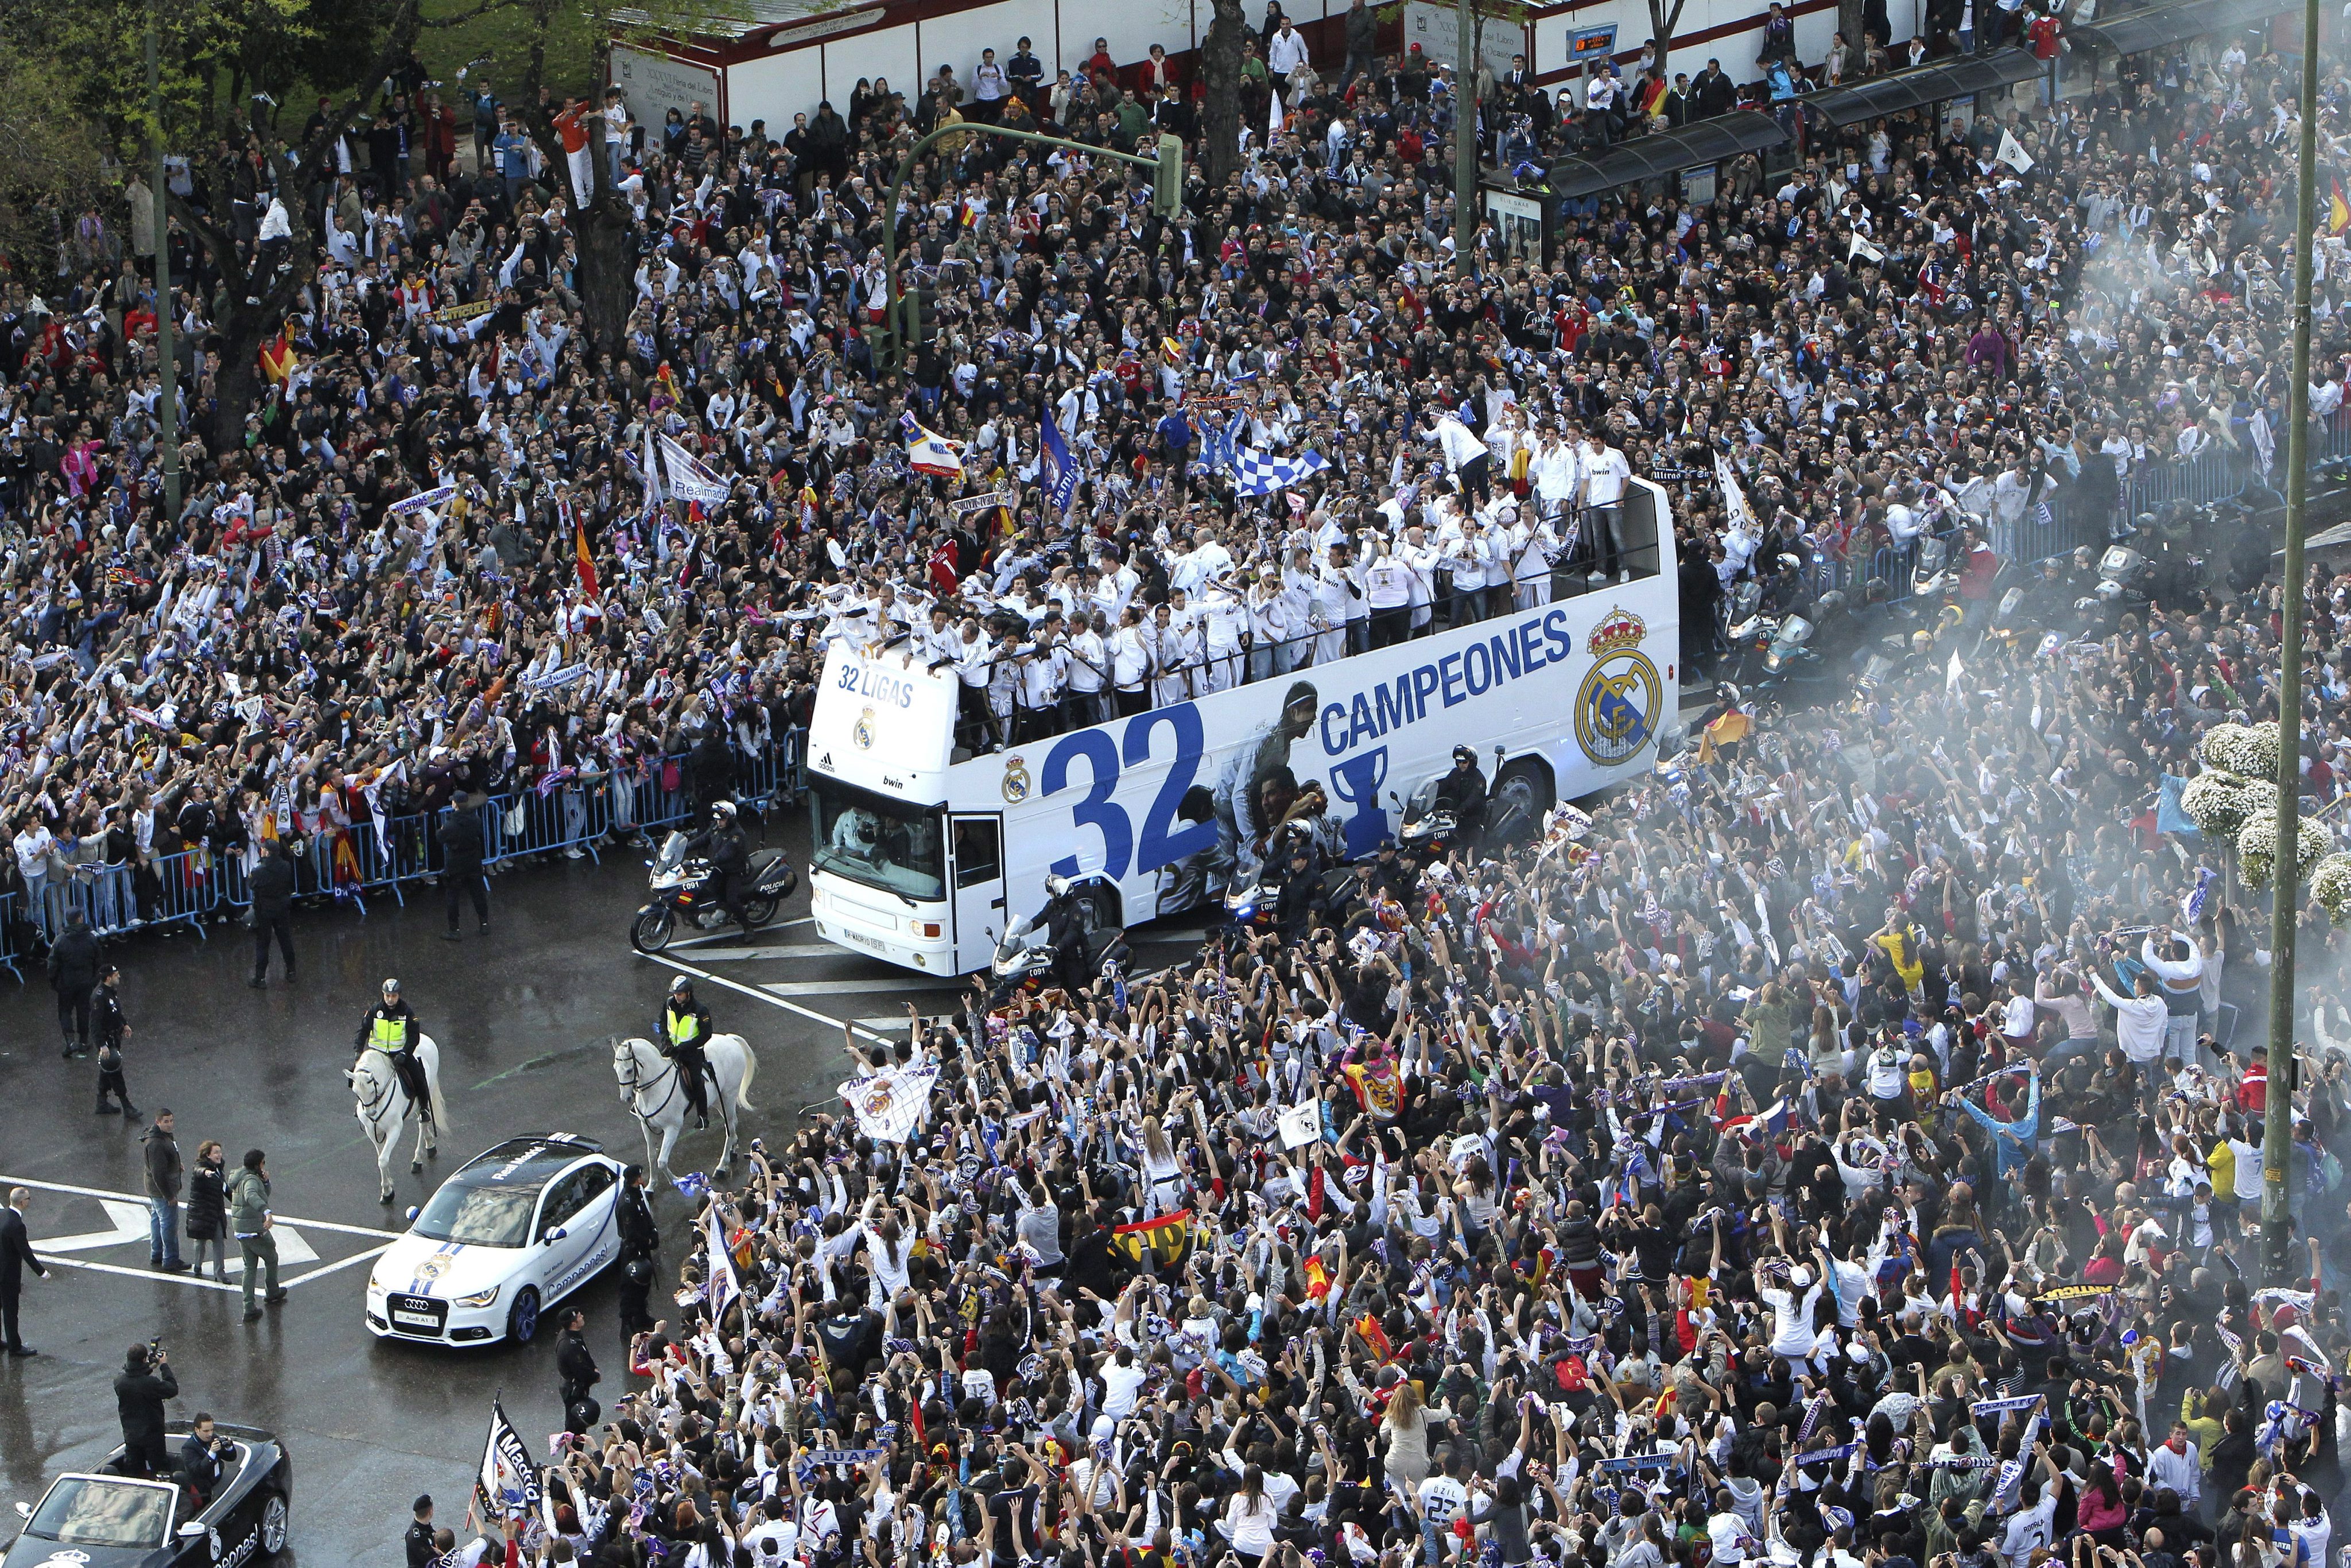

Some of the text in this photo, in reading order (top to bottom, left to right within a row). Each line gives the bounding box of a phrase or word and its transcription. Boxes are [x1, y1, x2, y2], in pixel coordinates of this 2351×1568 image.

[1496, 27, 1515, 45] Libro
[1500, 196, 1530, 208] ELIE SAAB
[674, 480, 731, 503] Realmadri
[942, 558, 957, 577] 1
[1216, 560, 1229, 571] bwin
[1322, 575, 1339, 588] bwin
[838, 664, 914, 709] 32 LIGAS
[1321, 608, 1572, 758] CAMPEONES
[818, 762, 836, 774] adidas
[883, 775, 903, 790] bwin
[1041, 701, 1219, 884] 32
[759, 879, 785, 892] POLICIA
[767, 887, 779, 895] CNP
[847, 930, 871, 946] R-MADRID
[491, 1146, 546, 1181] Real Madrid
[547, 1243, 608, 1301] Campeones!
[405, 1315, 420, 1323] Audi
[503, 1433, 540, 1502] Madrid
[1433, 1484, 1456, 1498] ÖZIL
[216, 1523, 259, 1568] eones!
